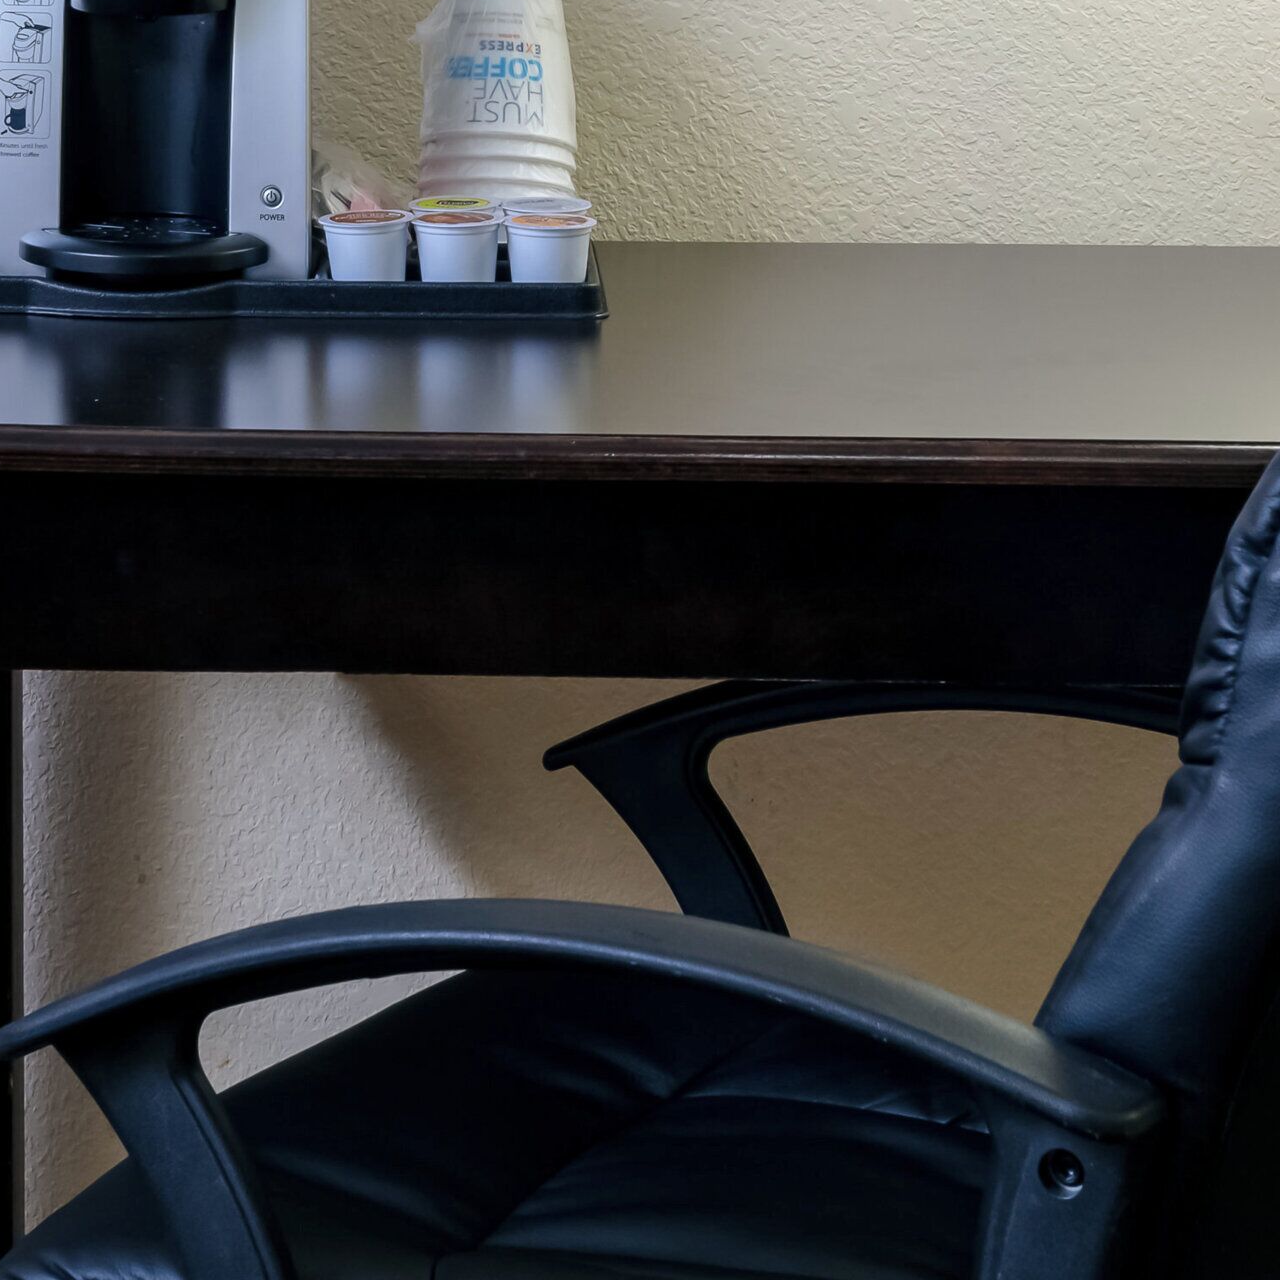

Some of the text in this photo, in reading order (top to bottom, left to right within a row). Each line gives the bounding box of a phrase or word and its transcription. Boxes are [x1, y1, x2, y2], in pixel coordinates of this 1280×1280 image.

[480, 40, 541, 55] EXPRESS
[474, 79, 542, 104] HAVE
[466, 101, 544, 127] MUST
